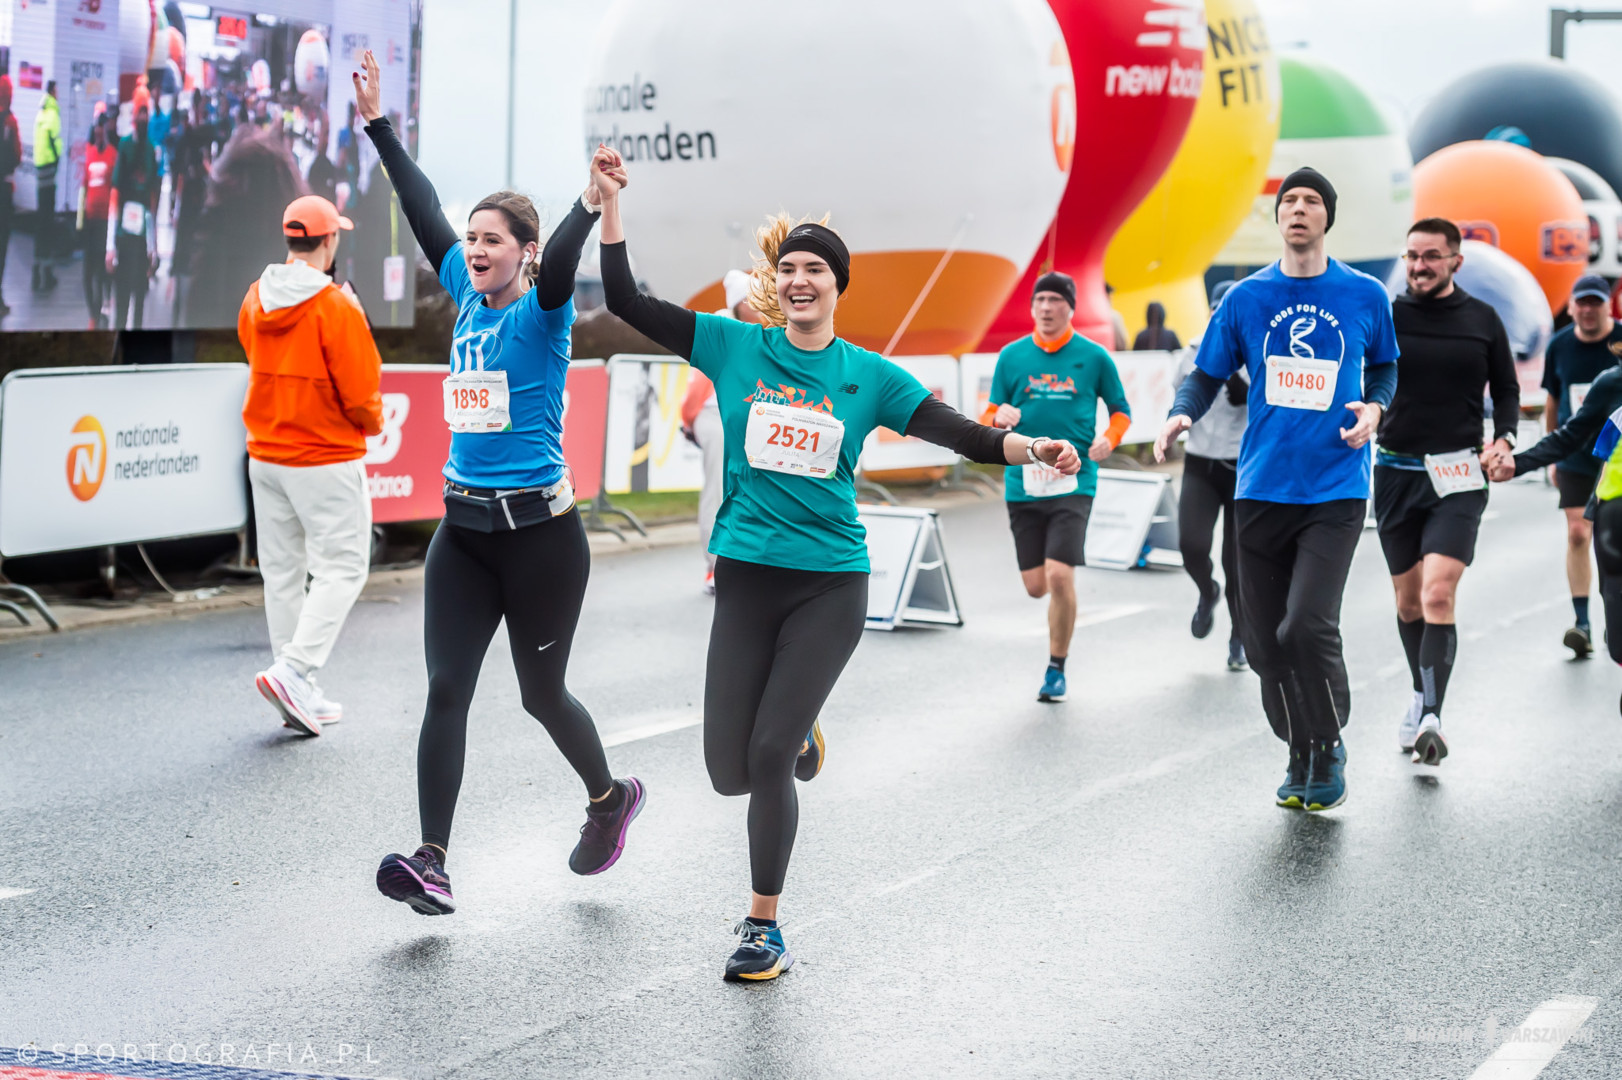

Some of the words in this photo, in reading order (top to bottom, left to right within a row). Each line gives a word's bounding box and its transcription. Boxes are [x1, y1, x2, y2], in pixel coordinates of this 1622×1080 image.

[1207, 17, 1269, 59] NIC
[1105, 64, 1169, 97] new
[1218, 64, 1262, 107] FIT
[1269, 306, 1294, 328] CODE
[1296, 304, 1317, 314] FOR
[1319, 308, 1340, 328] LIFE
[1277, 371, 1326, 391] 10480
[452, 388, 489, 409] 1898
[115, 420, 180, 448] nationale
[767, 423, 820, 453] 2521
[114, 448, 199, 480] nederlanden
